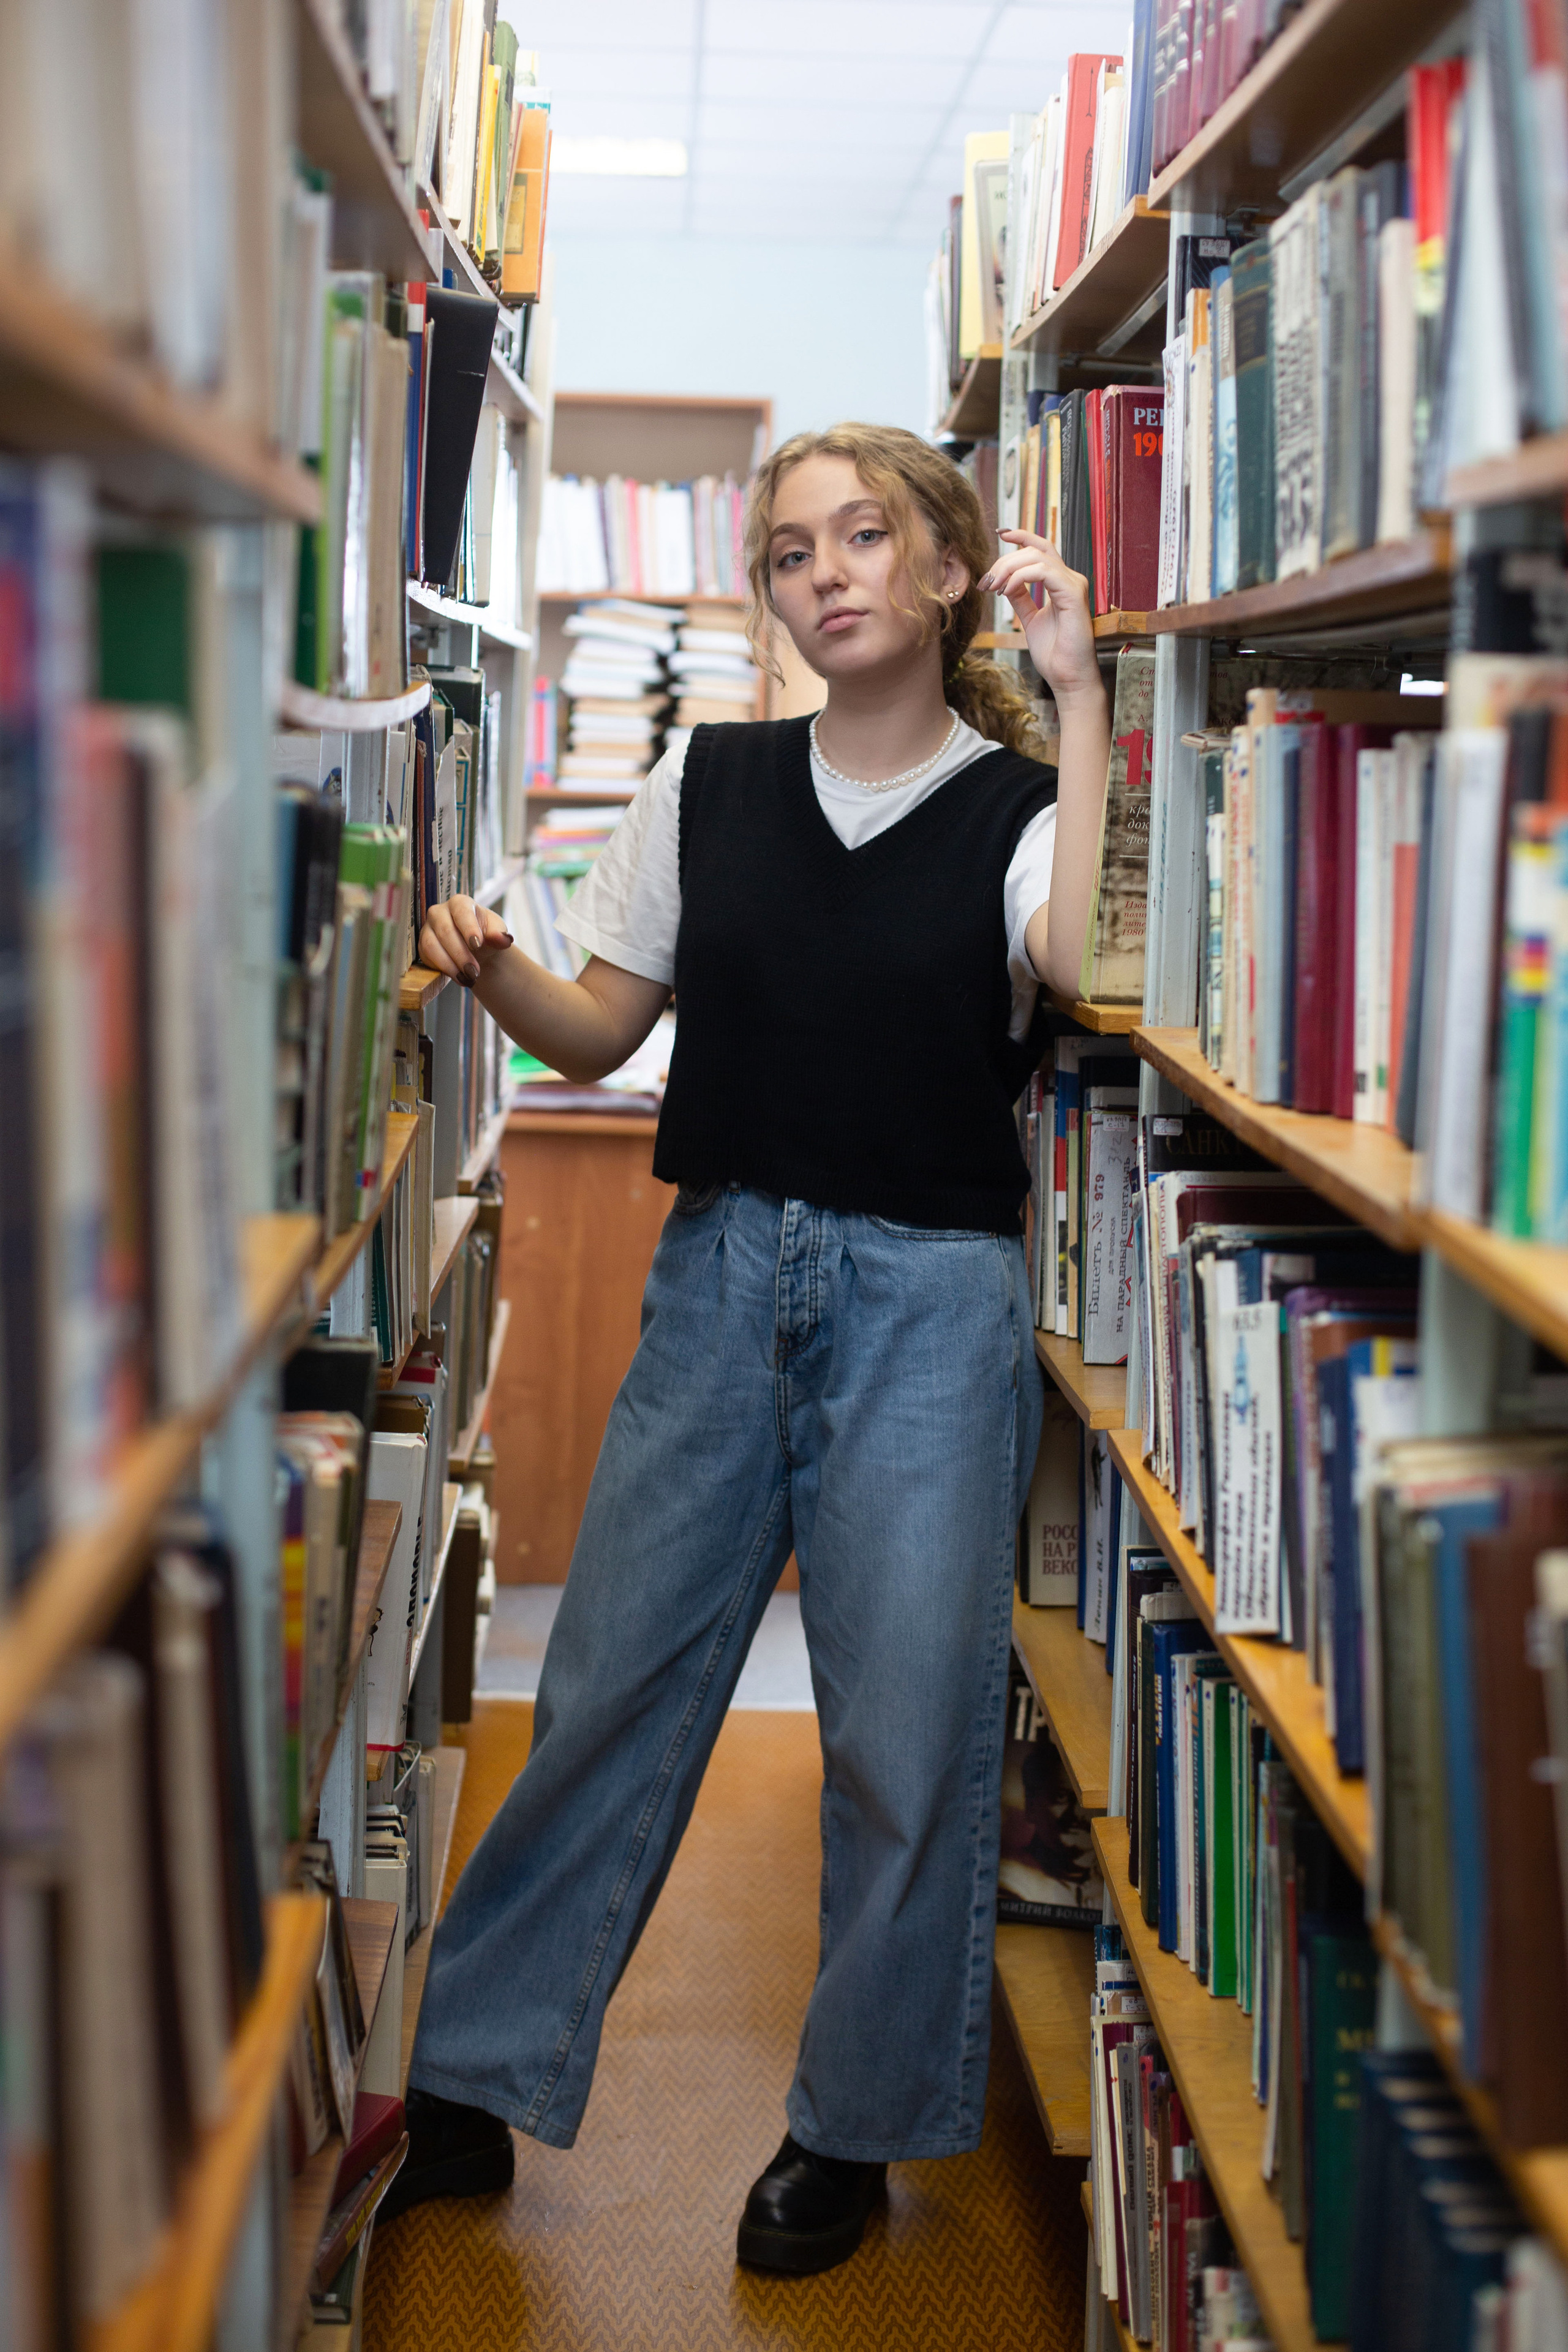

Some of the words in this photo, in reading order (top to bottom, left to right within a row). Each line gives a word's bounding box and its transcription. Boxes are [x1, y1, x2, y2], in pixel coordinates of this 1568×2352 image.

[1138, 689, 1149, 698] до
[1137, 714, 1148, 723] А.
[1116, 728, 1153, 785] 1
[1128, 818, 1150, 830] док
[1122, 928, 1144, 937] 1980
[1094, 1174, 1104, 1202] 979
[1120, 1157, 1130, 1235] СПЕКТАКЛЬ
[1117, 1238, 1127, 1311] ПАРАДНЫЙ
[1116, 1315, 1123, 1333] НА
[1042, 1524, 1078, 1540] РОСС
[1042, 1542, 1063, 1558] НА
[1042, 1559, 1078, 1575] ВЕКО
[1014, 1686, 1047, 1742] ТР
